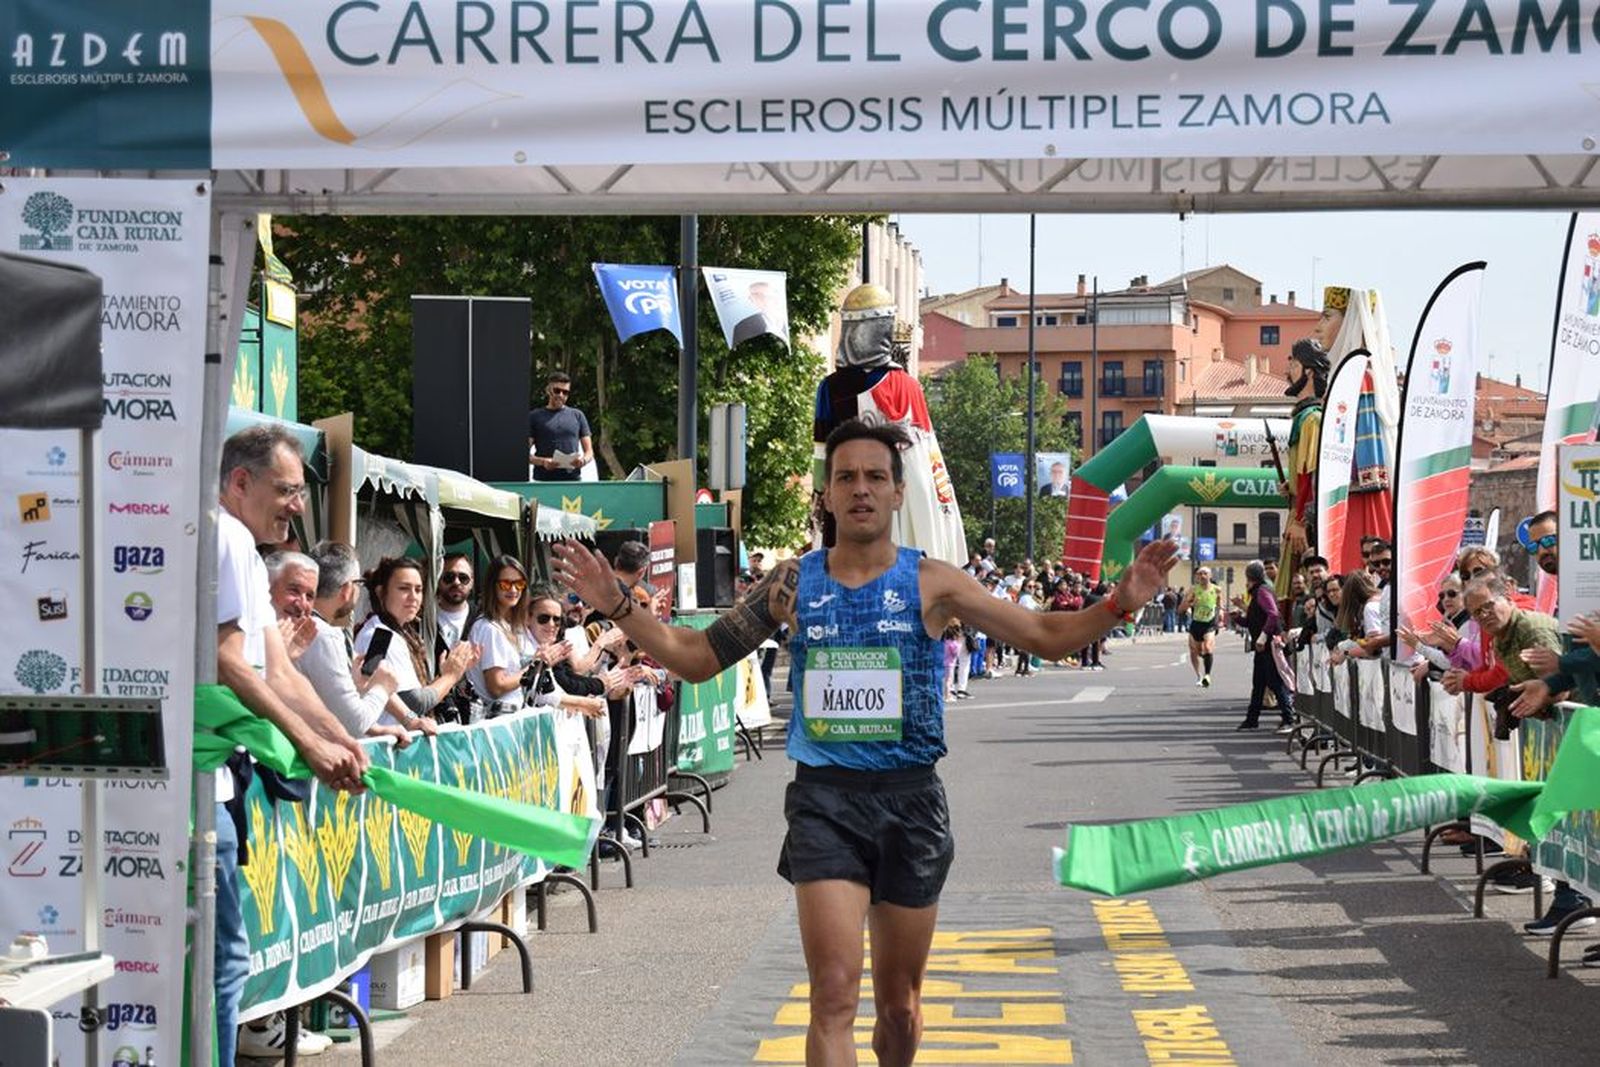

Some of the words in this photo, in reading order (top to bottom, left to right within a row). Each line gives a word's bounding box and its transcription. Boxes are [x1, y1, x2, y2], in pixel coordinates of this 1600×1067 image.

[326, 0, 720, 66] CARRERA
[755, 0, 901, 63] DEL
[927, 0, 1222, 62] CERCO
[1255, 0, 1352, 58] DE
[1383, 0, 1600, 56] ZAM
[13, 32, 187, 67] AZDEM
[11, 74, 78, 86] ESCLEROSIS
[81, 71, 133, 84] MÚLTIPLE
[137, 72, 188, 83] ZAMORA
[645, 97, 922, 134] ESCLEROSIS
[941, 88, 1161, 131] MÚLTIPLE
[1179, 92, 1391, 127] ZAMORA
[78, 209, 183, 226] FUNDACION
[78, 225, 119, 240] CAJA
[125, 226, 182, 242] RURAL
[79, 243, 92, 252] DE
[96, 243, 139, 253] ZAMORA
[618, 279, 670, 292] VOTA
[102, 295, 181, 311] TAMIENTO
[101, 311, 181, 331] AMORA
[103, 374, 171, 388] UTACION
[103, 399, 176, 421] MORA
[1424, 407, 1465, 421] ZAMORA
[998, 464, 1018, 472] VOTA
[1232, 479, 1280, 496] CAJA
[1570, 501, 1592, 529] LA
[114, 546, 165, 573] gaza
[831, 651, 888, 662] FUNDACION
[857, 661, 888, 669] RURAL
[828, 674, 834, 687] 2
[823, 688, 885, 712] MARCOS
[859, 724, 897, 735] RURAL
[1212, 820, 1288, 867] CARRERA
[1288, 813, 1316, 855] del
[1315, 804, 1369, 850] CERCO
[1371, 799, 1389, 838] de
[1391, 788, 1458, 834] ZAMORA
[107, 1003, 157, 1031] gaza
